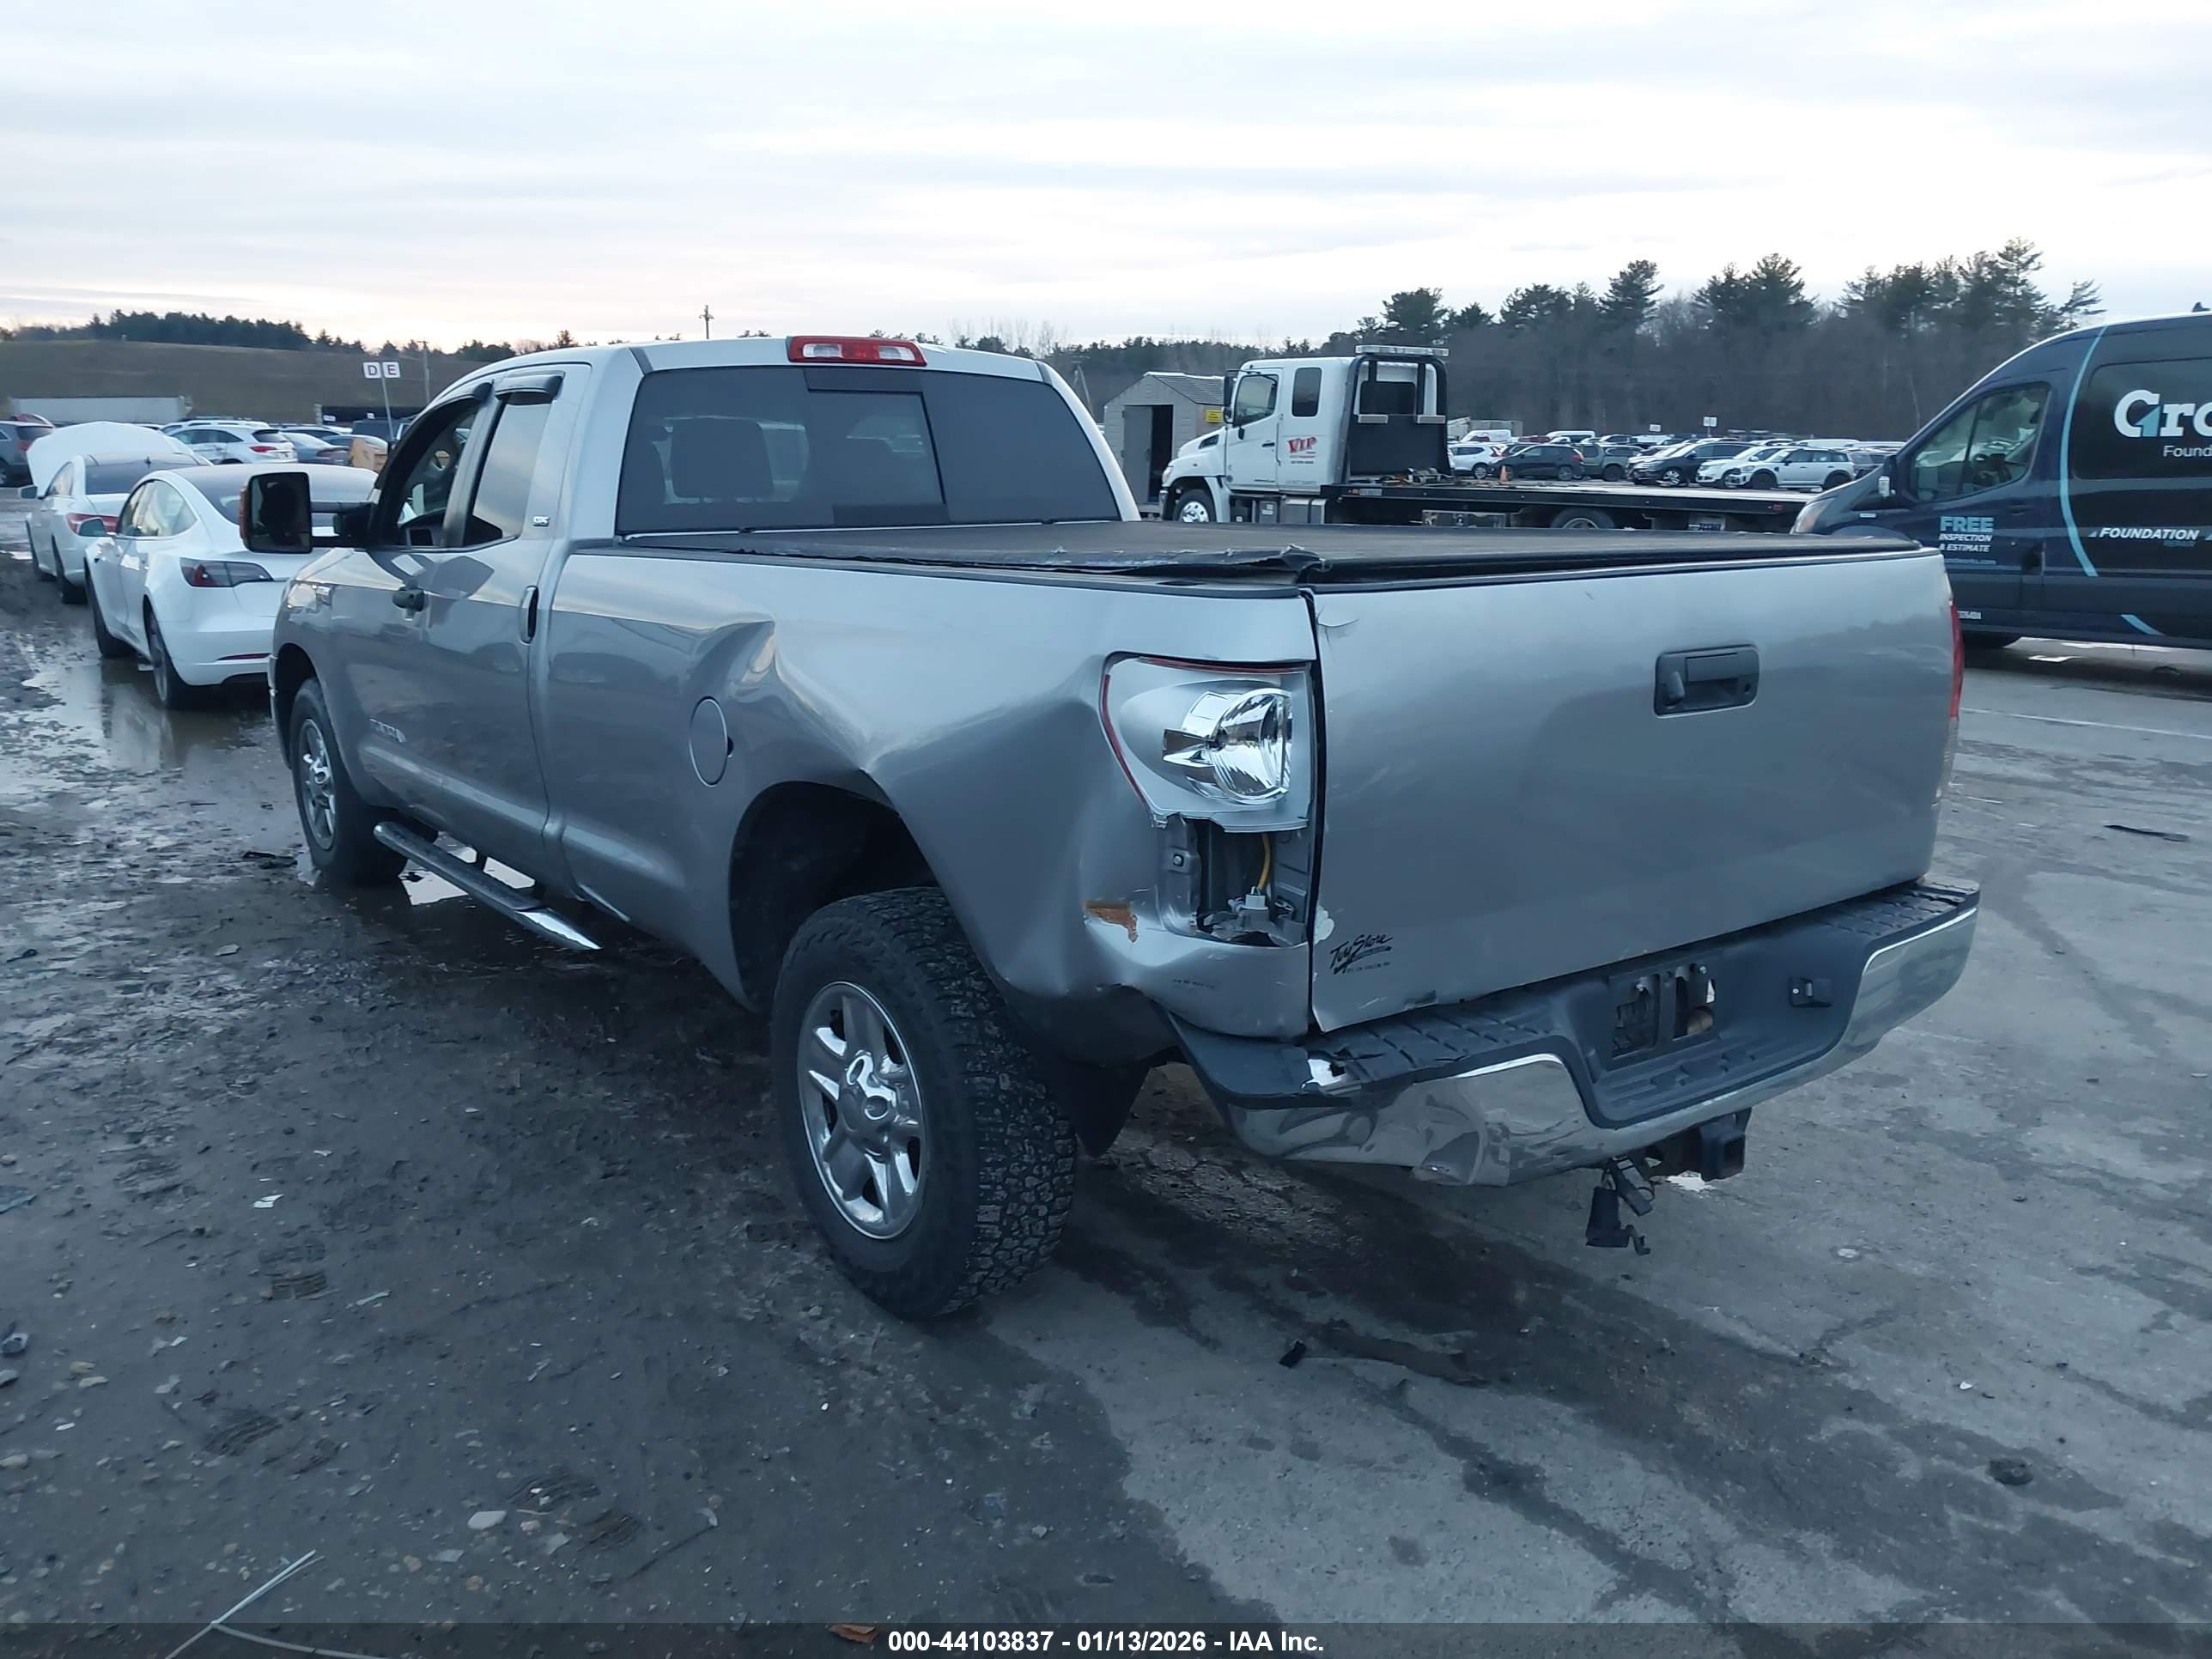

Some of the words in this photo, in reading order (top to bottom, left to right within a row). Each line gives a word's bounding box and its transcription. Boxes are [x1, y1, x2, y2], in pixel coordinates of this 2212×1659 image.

[368, 364, 378, 376] D
[387, 364, 397, 375] E
[1287, 436, 1317, 453] VIP
[1940, 516, 1994, 532] FREE
[1938, 533, 1993, 542] INSPECTION
[2099, 527, 2200, 540] FOUNDATION
[1947, 544, 1991, 552] ESTIMATE
